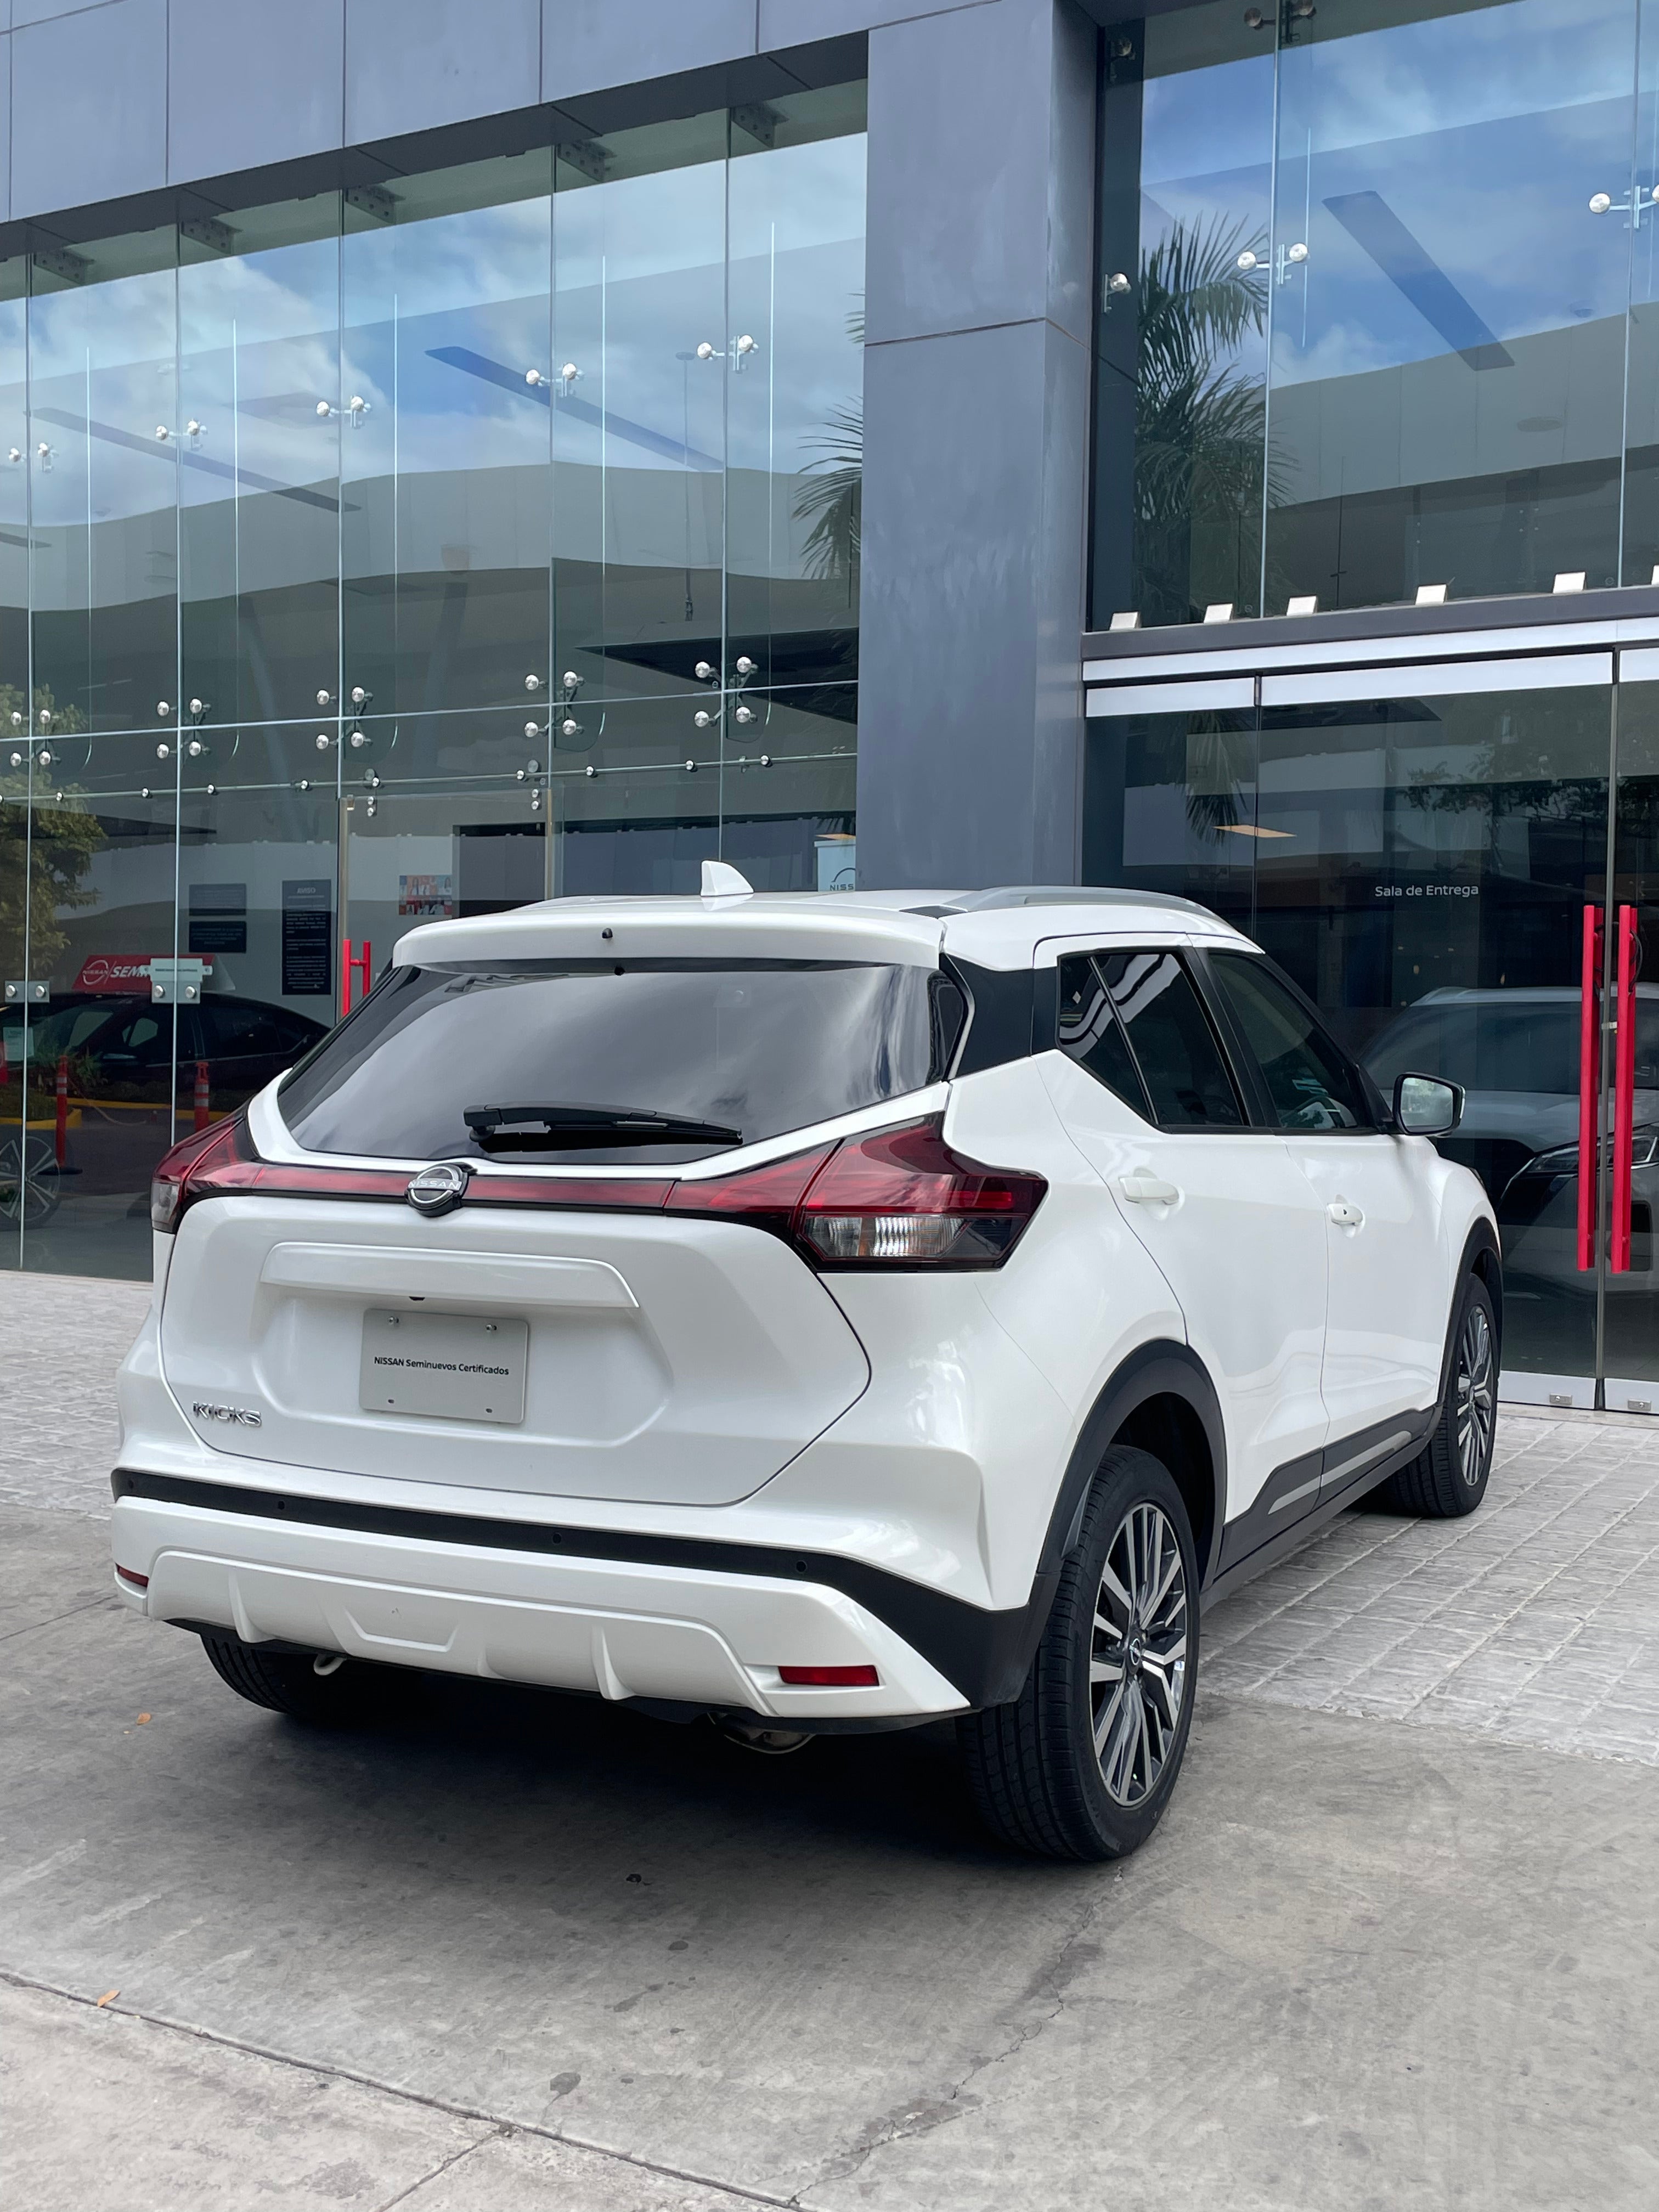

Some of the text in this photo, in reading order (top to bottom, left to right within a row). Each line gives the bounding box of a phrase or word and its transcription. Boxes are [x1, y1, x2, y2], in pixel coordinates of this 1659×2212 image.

[1375, 885, 1479, 898] Sala de Entrega
[110, 966, 148, 978] SEM
[408, 1180, 462, 1190] NISSAN
[374, 1356, 509, 1375] NISSAN Seminuevos Certificados
[193, 1401, 262, 1427] KICKS
